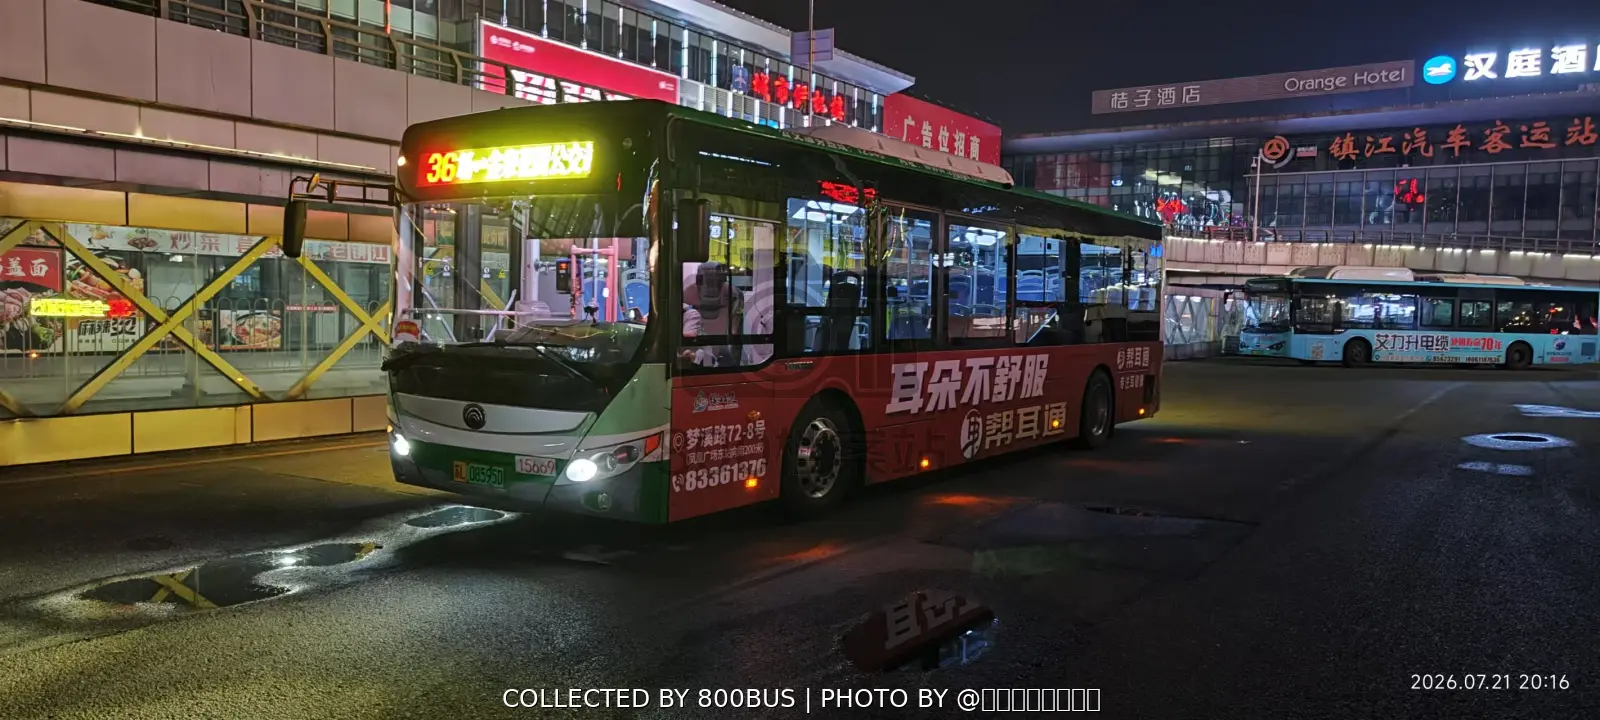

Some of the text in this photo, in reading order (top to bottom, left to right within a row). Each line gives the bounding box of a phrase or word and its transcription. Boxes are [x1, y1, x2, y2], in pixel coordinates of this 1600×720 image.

[1463, 44, 1600, 81] 汉庭酒
[1284, 67, 1405, 92] Orange Hotel
[1110, 85, 1200, 109] 桔子酒店
[903, 115, 981, 161] 广告位招商
[1329, 116, 1599, 160] 镇江汽车客运站
[0, 257, 49, 278] 盖面
[1376, 334, 1449, 351] 艾力升电缆
[886, 354, 1049, 415] 耳朵不舒服
[686, 420, 766, 450] 梦溪路72-8号
[984, 402, 1067, 449] 帮耳通
[519, 458, 555, 474] 15669
[685, 458, 767, 491] 83361376
